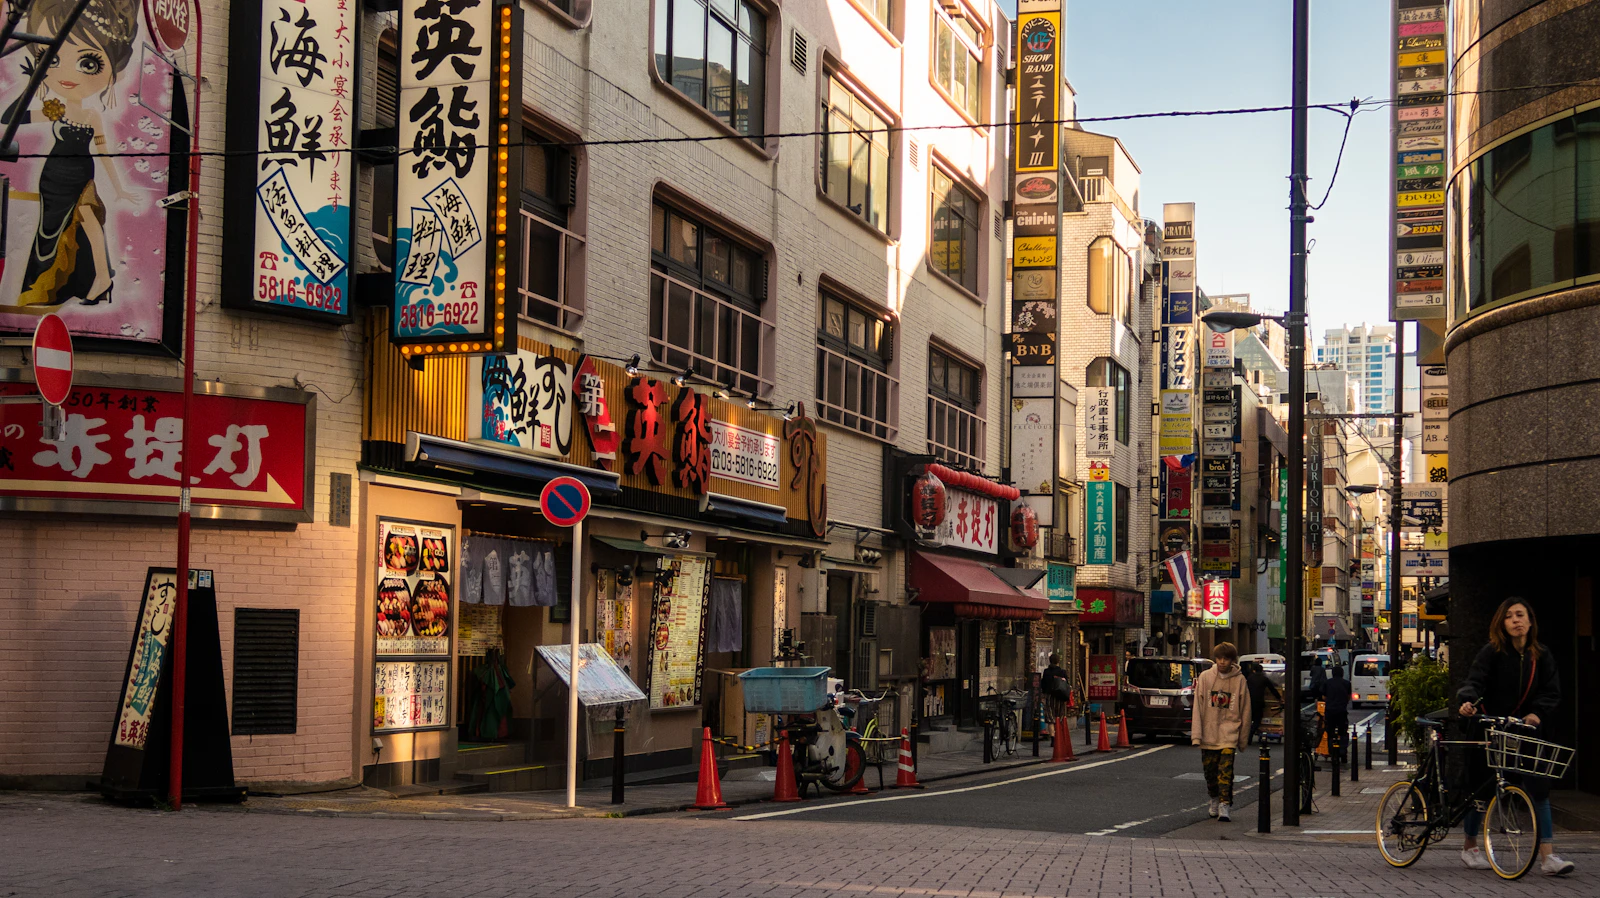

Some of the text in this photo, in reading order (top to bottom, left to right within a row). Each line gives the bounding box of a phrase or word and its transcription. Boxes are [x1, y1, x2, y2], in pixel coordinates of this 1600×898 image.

[1022, 53, 1053, 64] SHOW
[1025, 63, 1054, 74] BAND
[261, 6, 328, 183] 海鮮
[1411, 81, 1423, 92] 春
[1403, 124, 1443, 132] Copain
[1404, 193, 1441, 201] わいわい
[405, 214, 442, 280] 料理
[1165, 225, 1191, 237] GRATIA
[1412, 225, 1443, 234] EDEN
[1019, 255, 1053, 264] チャレンジ
[258, 274, 342, 311] 5816-6922
[400, 301, 479, 328] 5816-6922
[1173, 329, 1187, 386] クリスタル
[68, 391, 160, 413] 50年創業
[580, 373, 617, 461] 第二
[1098, 389, 1109, 450] 行政書士事務所
[1089, 404, 1097, 440] ダイモン
[32, 413, 269, 488] 赤提灯
[1209, 463, 1227, 471] brat
[1309, 425, 1320, 561] CENTURION HOTEL
[956, 497, 995, 549] 赤提灯
[1093, 521, 1107, 560] 不動産
[151, 577, 175, 636] すし
